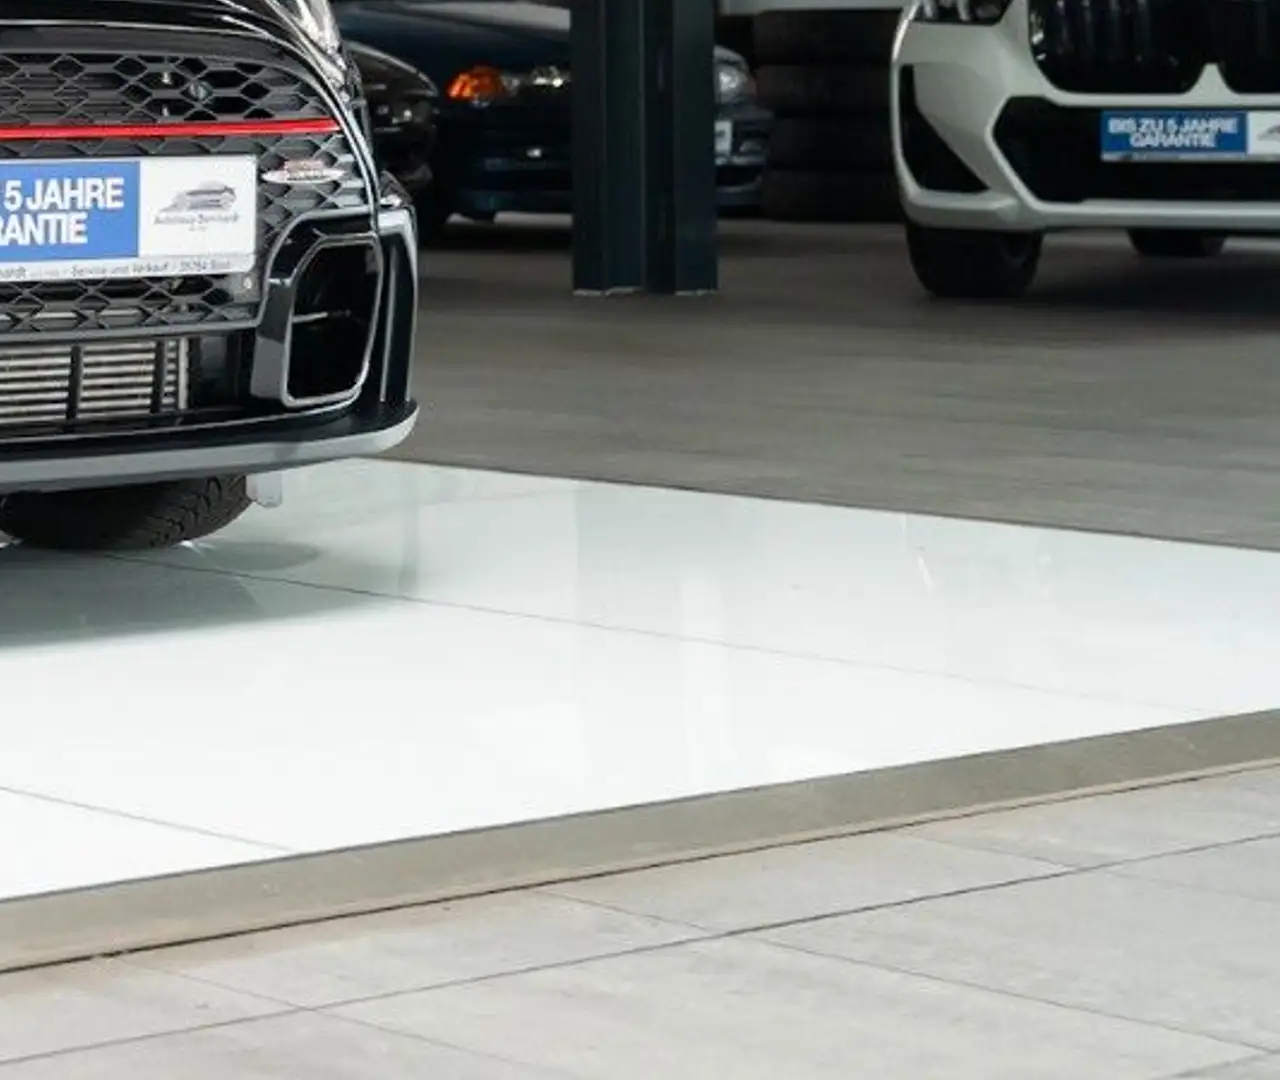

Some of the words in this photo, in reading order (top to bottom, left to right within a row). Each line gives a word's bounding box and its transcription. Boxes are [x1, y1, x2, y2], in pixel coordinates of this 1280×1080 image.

[1108, 118, 1135, 133] BIS
[1139, 118, 1164, 133] ZU
[1179, 118, 1238, 134] JAHRE
[1129, 133, 1217, 148] GARANTIE
[3, 180, 23, 211] 5
[26, 177, 125, 211] JAHRE
